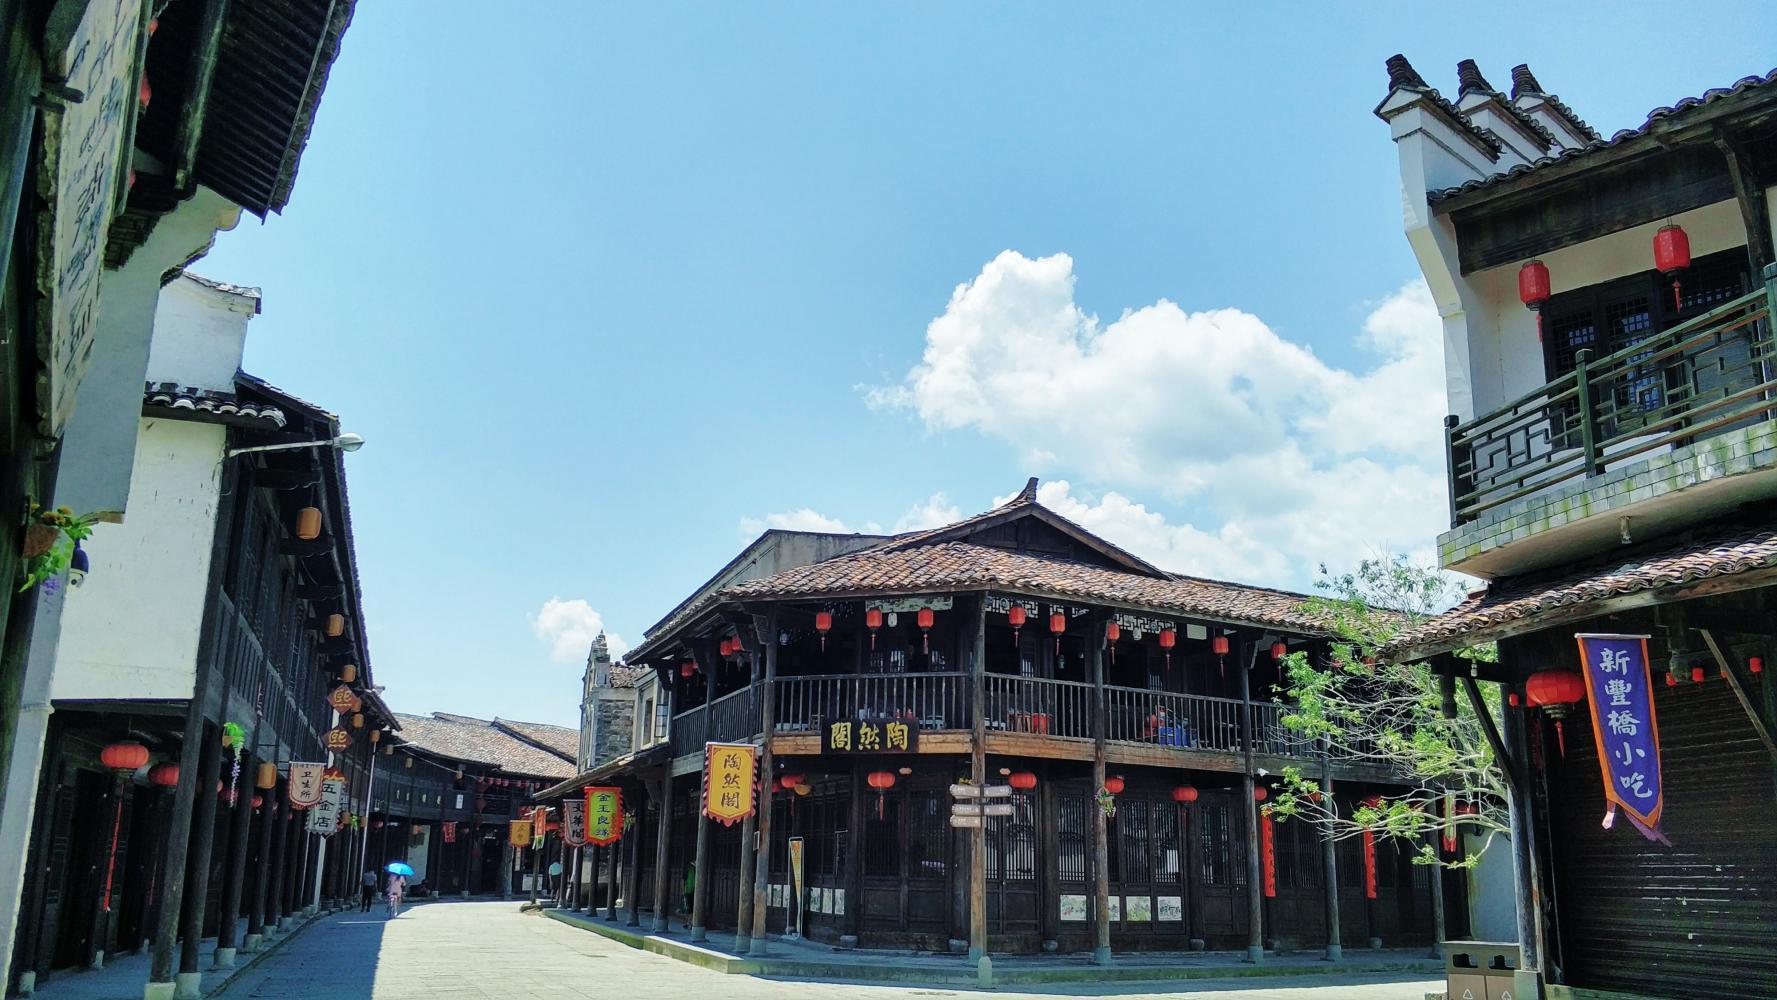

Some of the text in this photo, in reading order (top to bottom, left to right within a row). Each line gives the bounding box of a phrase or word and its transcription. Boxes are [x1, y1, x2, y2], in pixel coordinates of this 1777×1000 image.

[1599, 647, 1652, 798] 新豐橋小吃
[314, 783, 337, 828] 五金店
